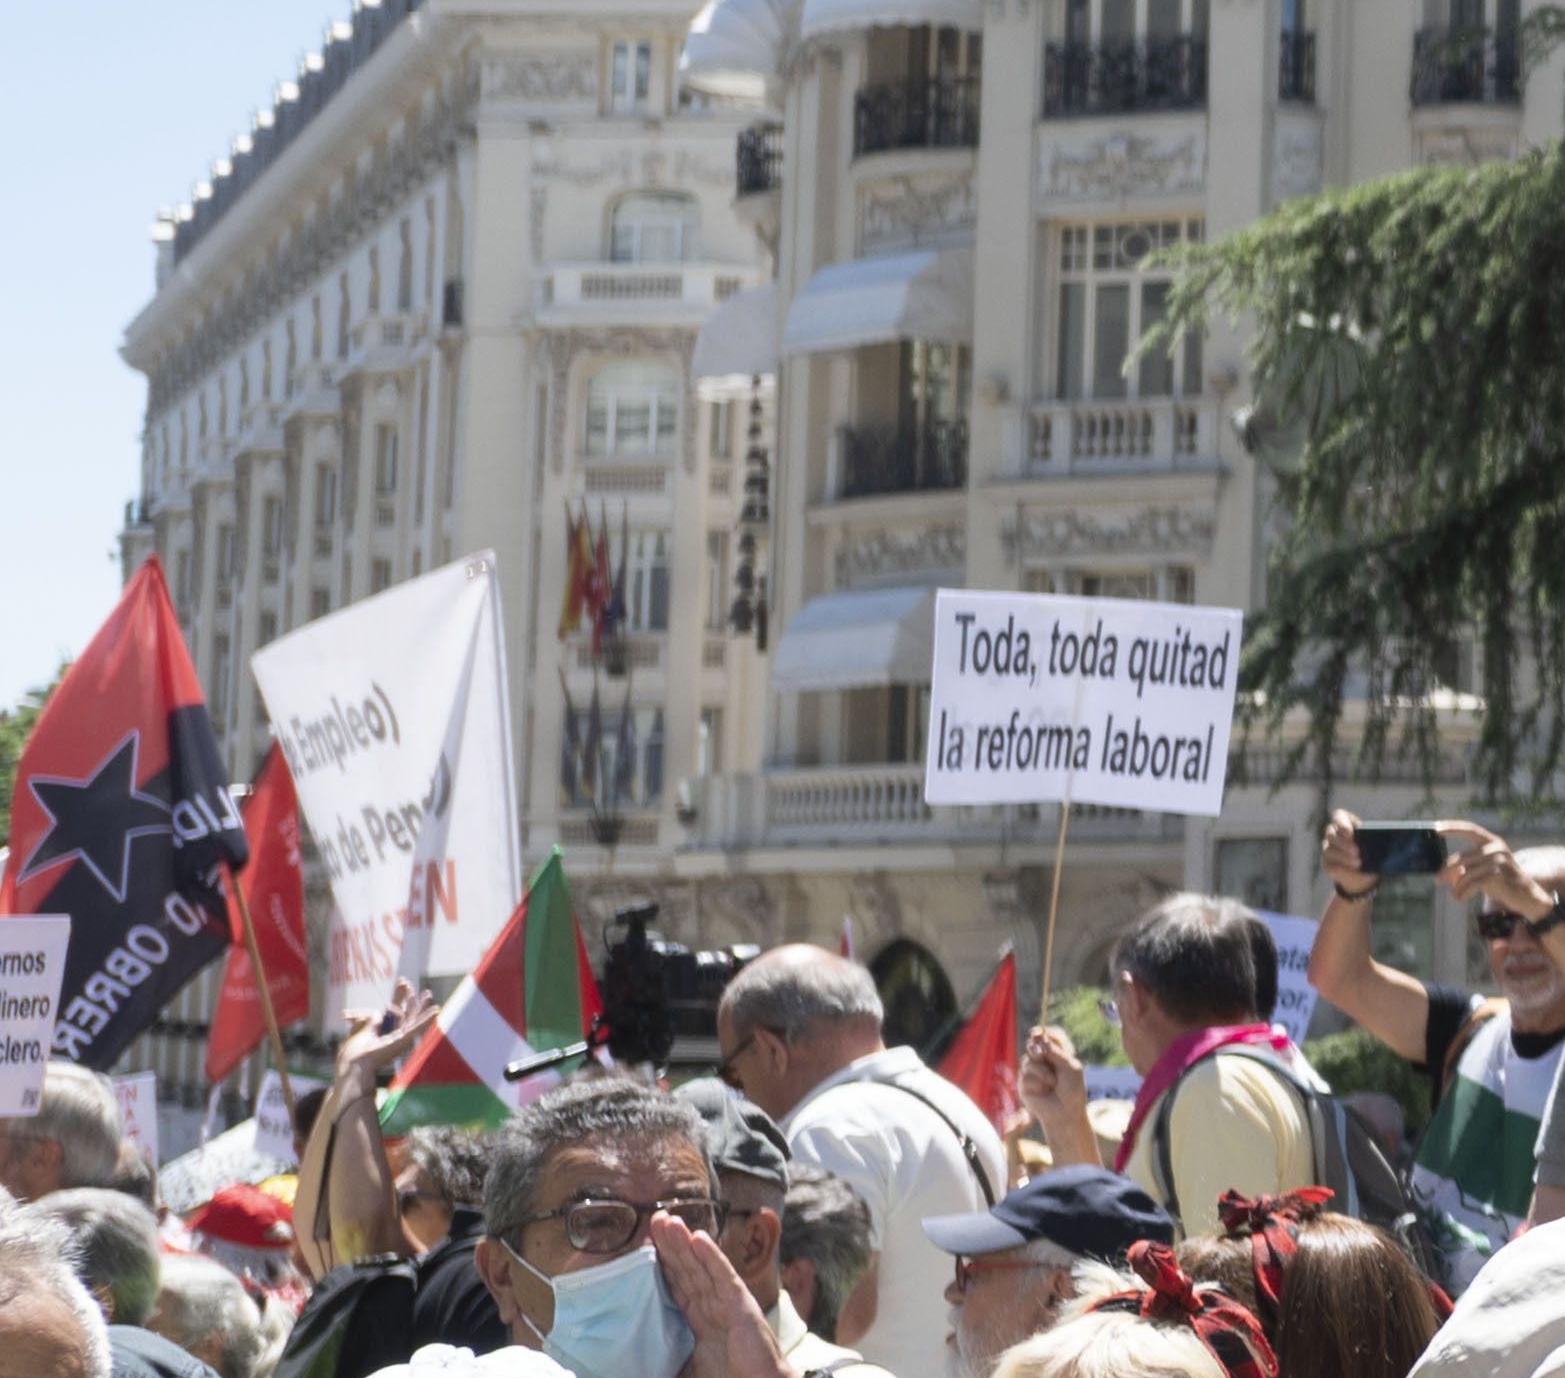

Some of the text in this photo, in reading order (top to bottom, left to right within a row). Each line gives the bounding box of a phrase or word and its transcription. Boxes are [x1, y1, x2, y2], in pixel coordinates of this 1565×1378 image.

[955, 612, 1230, 698] Toda, toda quitad
[938, 708, 1214, 784] la reforma laboral
